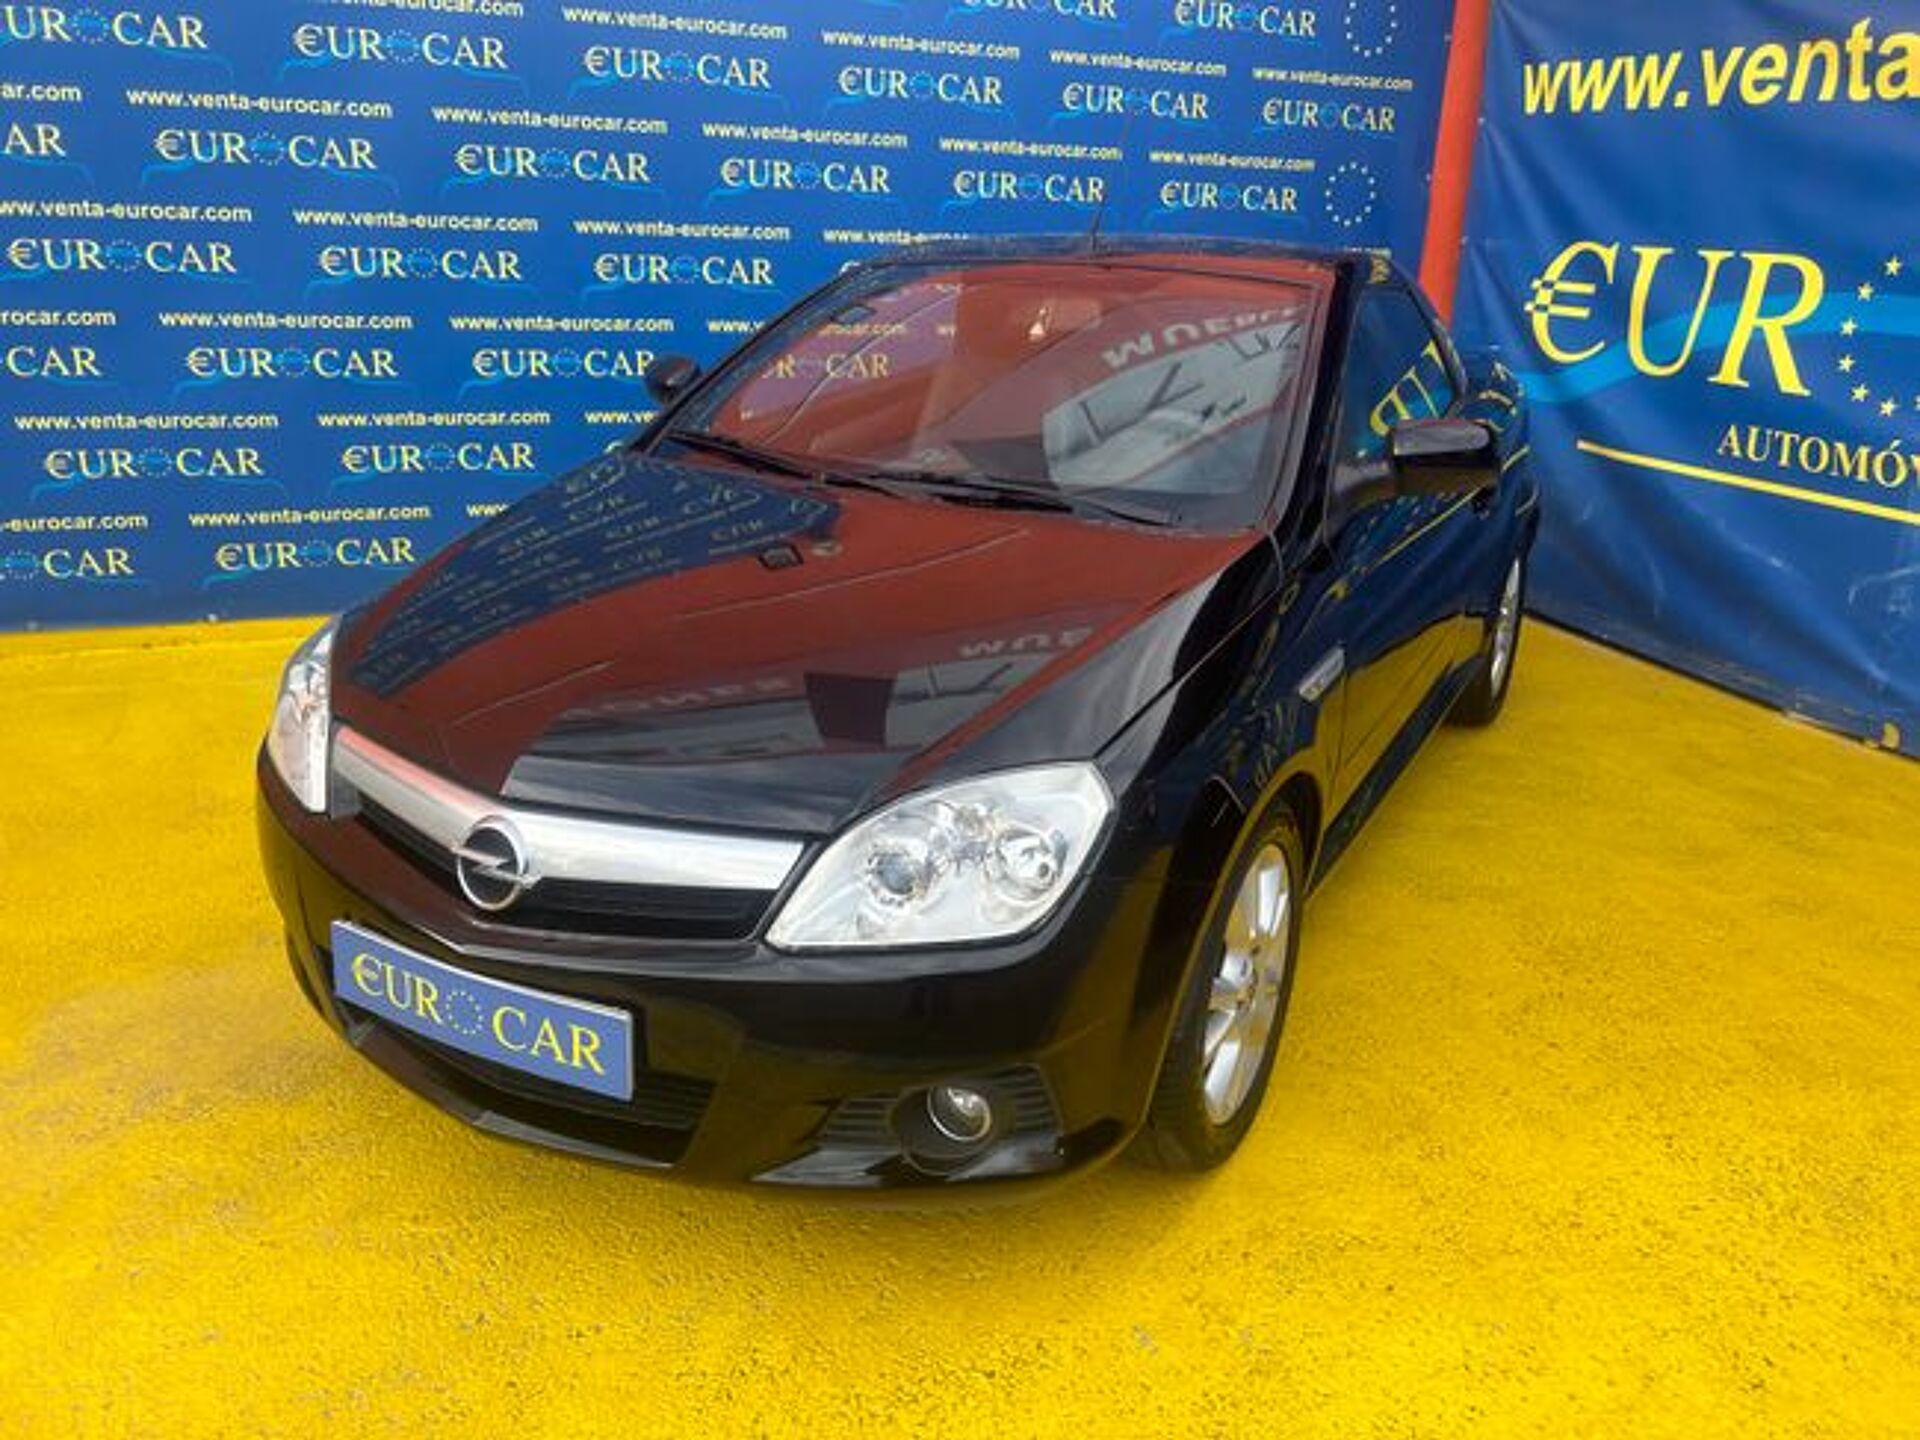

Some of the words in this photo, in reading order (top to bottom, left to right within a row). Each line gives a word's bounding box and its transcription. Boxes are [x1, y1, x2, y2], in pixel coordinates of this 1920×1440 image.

[563, 8, 787, 39] www.venta-eurocar.com
[822, 31, 1019, 58] www.venta-eurocar.com
[1050, 50, 1226, 76] www.venta-eurocar.com
[1253, 68, 1413, 90] www.venta-eurocar.com
[127, 91, 392, 117] www.venta-eurocar.com
[432, 108, 667, 133] www.venta-eurocar.com
[703, 123, 907, 147] www.venta-eurocar.com
[940, 138, 1122, 160] www.venta-eurocar.com
[1150, 151, 1314, 171] www.venta-eurocar.com
[293, 211, 538, 231] www.venta-eurocar.com
[574, 221, 789, 239] www.venta-eurocar.com
[159, 312, 412, 329] www.venta-eurocar.com
[450, 316, 673, 331] www.venta-eurocar.com
[15, 414, 278, 429] www.venta-eurocar.com
[318, 412, 550, 426] www.venta-eurocar.com
[189, 507, 430, 526] www.venta-eurocar.com
